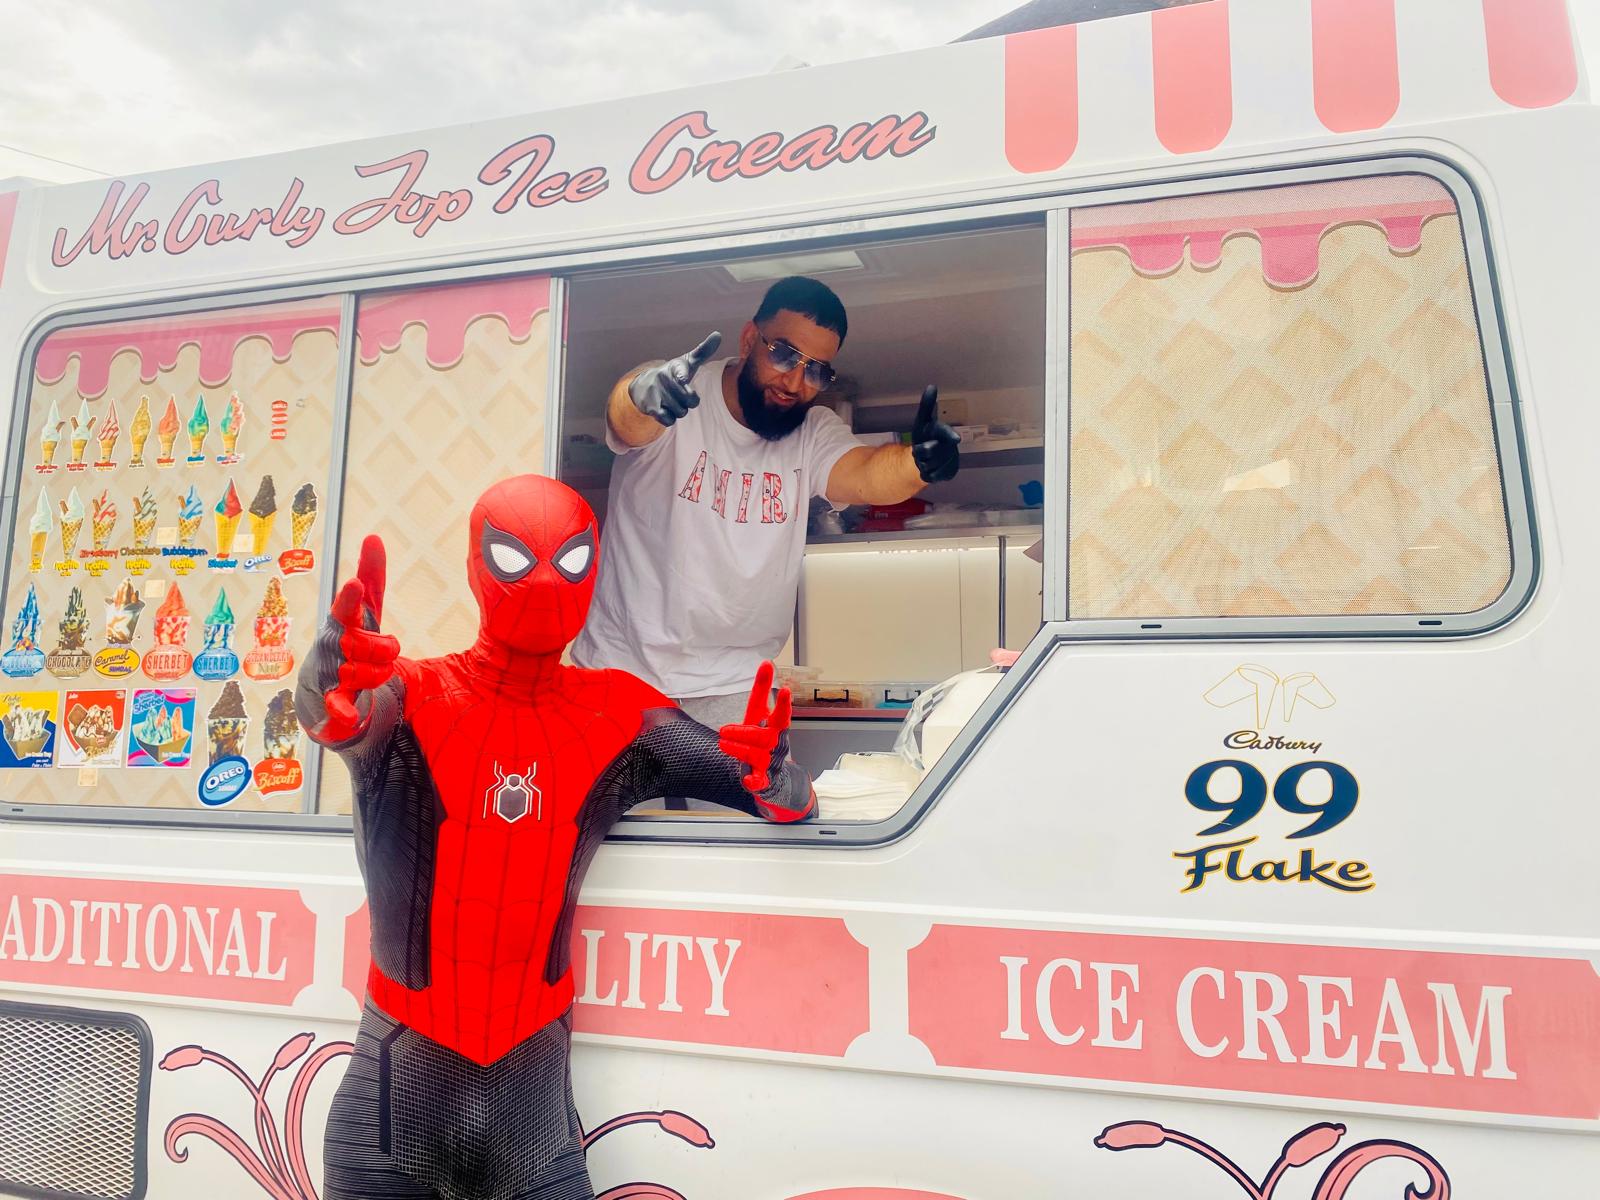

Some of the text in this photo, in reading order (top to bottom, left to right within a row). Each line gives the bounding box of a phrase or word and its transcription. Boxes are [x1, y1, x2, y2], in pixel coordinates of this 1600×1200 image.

[52, 111, 937, 267] Mr. Curly Top Ice Cream
[95, 649, 130, 666] Caramel
[147, 654, 188, 670] SHERBET
[198, 656, 235, 671] SHERBET
[1223, 730, 1323, 753] Cadbury
[205, 767, 244, 790] OREO
[254, 768, 300, 789] Biscoff
[1184, 758, 1359, 839] 99
[1171, 835, 1377, 893] Flake
[573, 929, 742, 1017] LITY
[1000, 956, 1144, 1050] ICE
[1176, 966, 1518, 1080] CREAM
